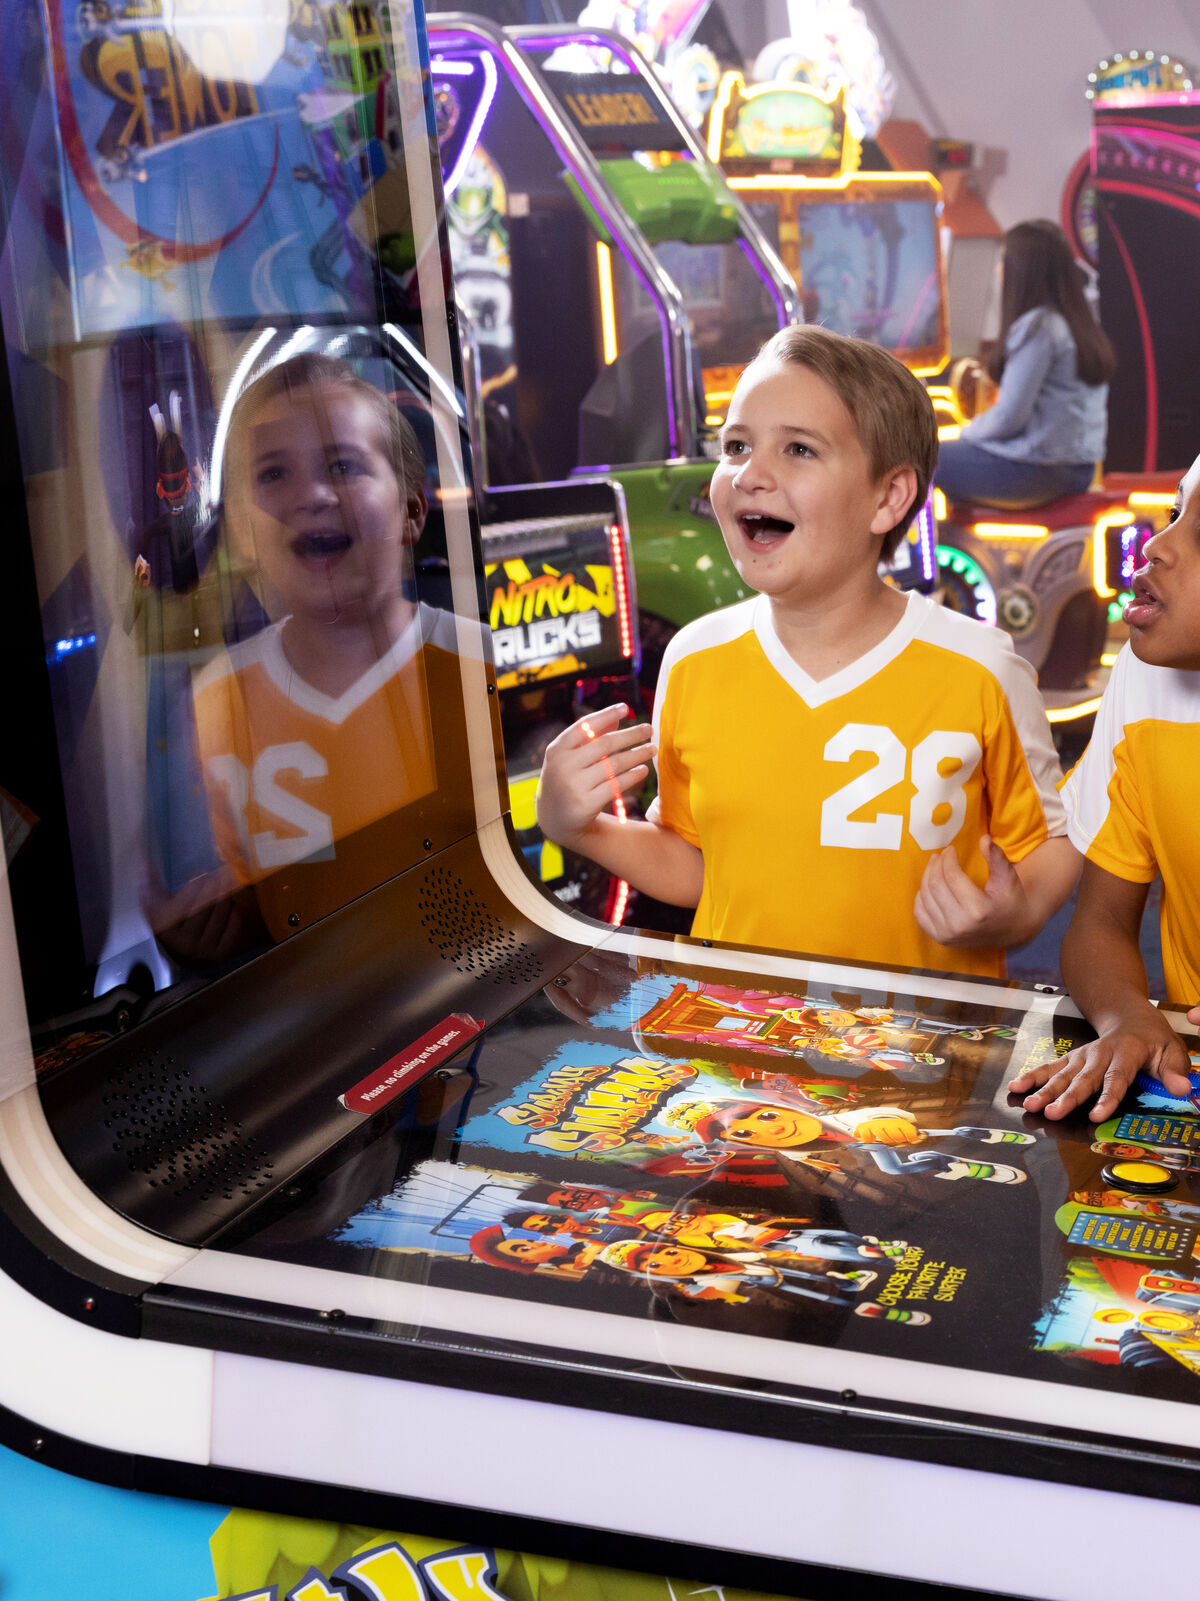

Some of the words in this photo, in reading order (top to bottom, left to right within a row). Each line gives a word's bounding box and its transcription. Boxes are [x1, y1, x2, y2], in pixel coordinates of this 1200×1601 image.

[490, 573, 575, 630] NITRO
[492, 609, 601, 667] RUCKS
[820, 723, 982, 850] 28
[360, 1082, 391, 1101] Please,
[384, 1077, 397, 1086] no
[393, 1057, 426, 1079] climbing
[419, 1051, 431, 1059] on
[425, 1042, 441, 1054] the
[437, 1030, 461, 1046] games.
[497, 1065, 611, 1129] SUBWAY
[525, 1056, 699, 1152] SURFERS
[1128, 1126, 1137, 1135] JUST
[1138, 1127, 1148, 1136] SURE
[1082, 1227, 1094, 1240] AVOID
[1087, 1219, 1098, 1227] THE
[1094, 1225, 1108, 1240] TRAINS
[1105, 1222, 1121, 1244] OBSTACLES
[1119, 1227, 1131, 1241] WHILE
[1129, 1224, 1145, 1248] COLLECTING
[1144, 1229, 1155, 1241] MANY
[1153, 1236, 1165, 1249] COINS
[1165, 1241, 1176, 1250] YOU
[1169, 1232, 1179, 1241] CAN
[876, 1272, 913, 1306] CHOOSE
[895, 1248, 925, 1271] YOUR
[905, 1261, 946, 1300] FAVORITE
[933, 1266, 967, 1302] SURFER
